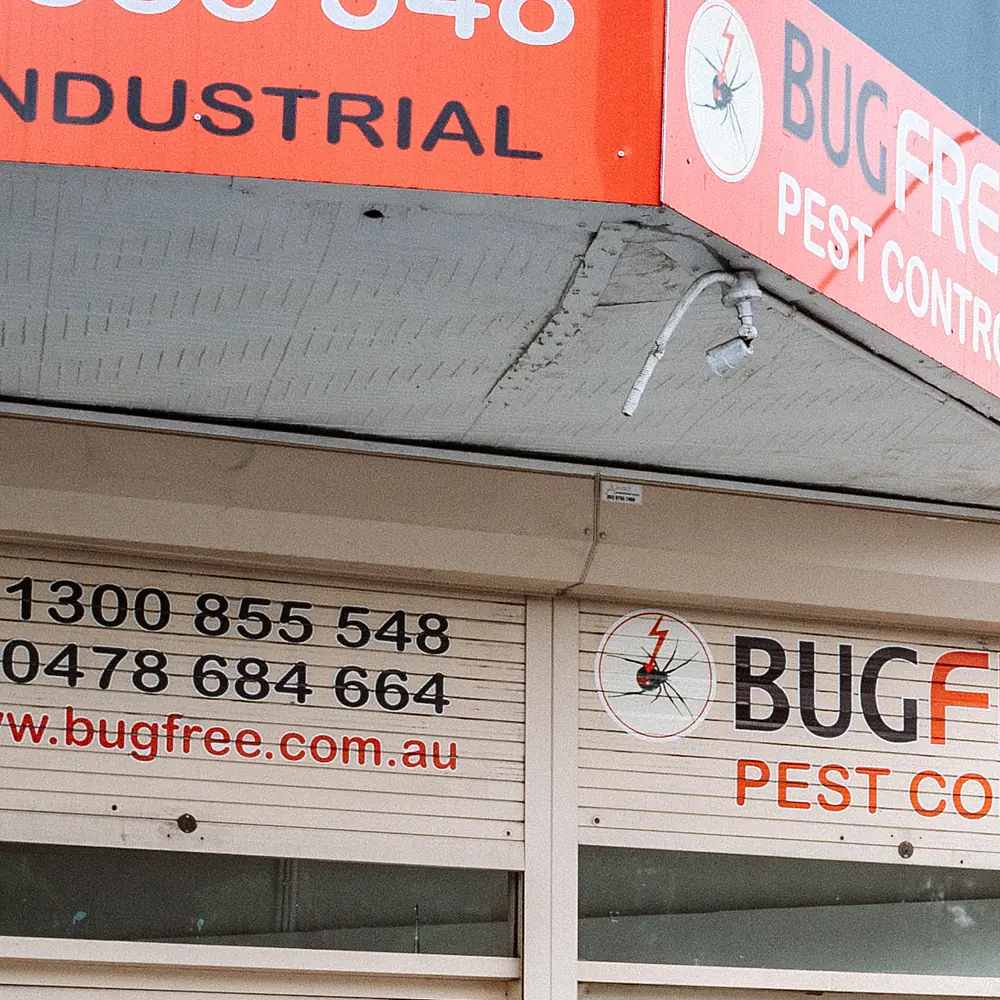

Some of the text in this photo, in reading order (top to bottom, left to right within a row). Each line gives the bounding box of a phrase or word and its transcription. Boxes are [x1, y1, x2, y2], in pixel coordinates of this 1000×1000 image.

[777, 171, 873, 284] PEST
[5, 576, 451, 655] 1300 855 548
[1, 638, 450, 715] 0478 684 664
[0, 706, 458, 771] w.bugfree.com.au
[736, 759, 891, 814] PEST
